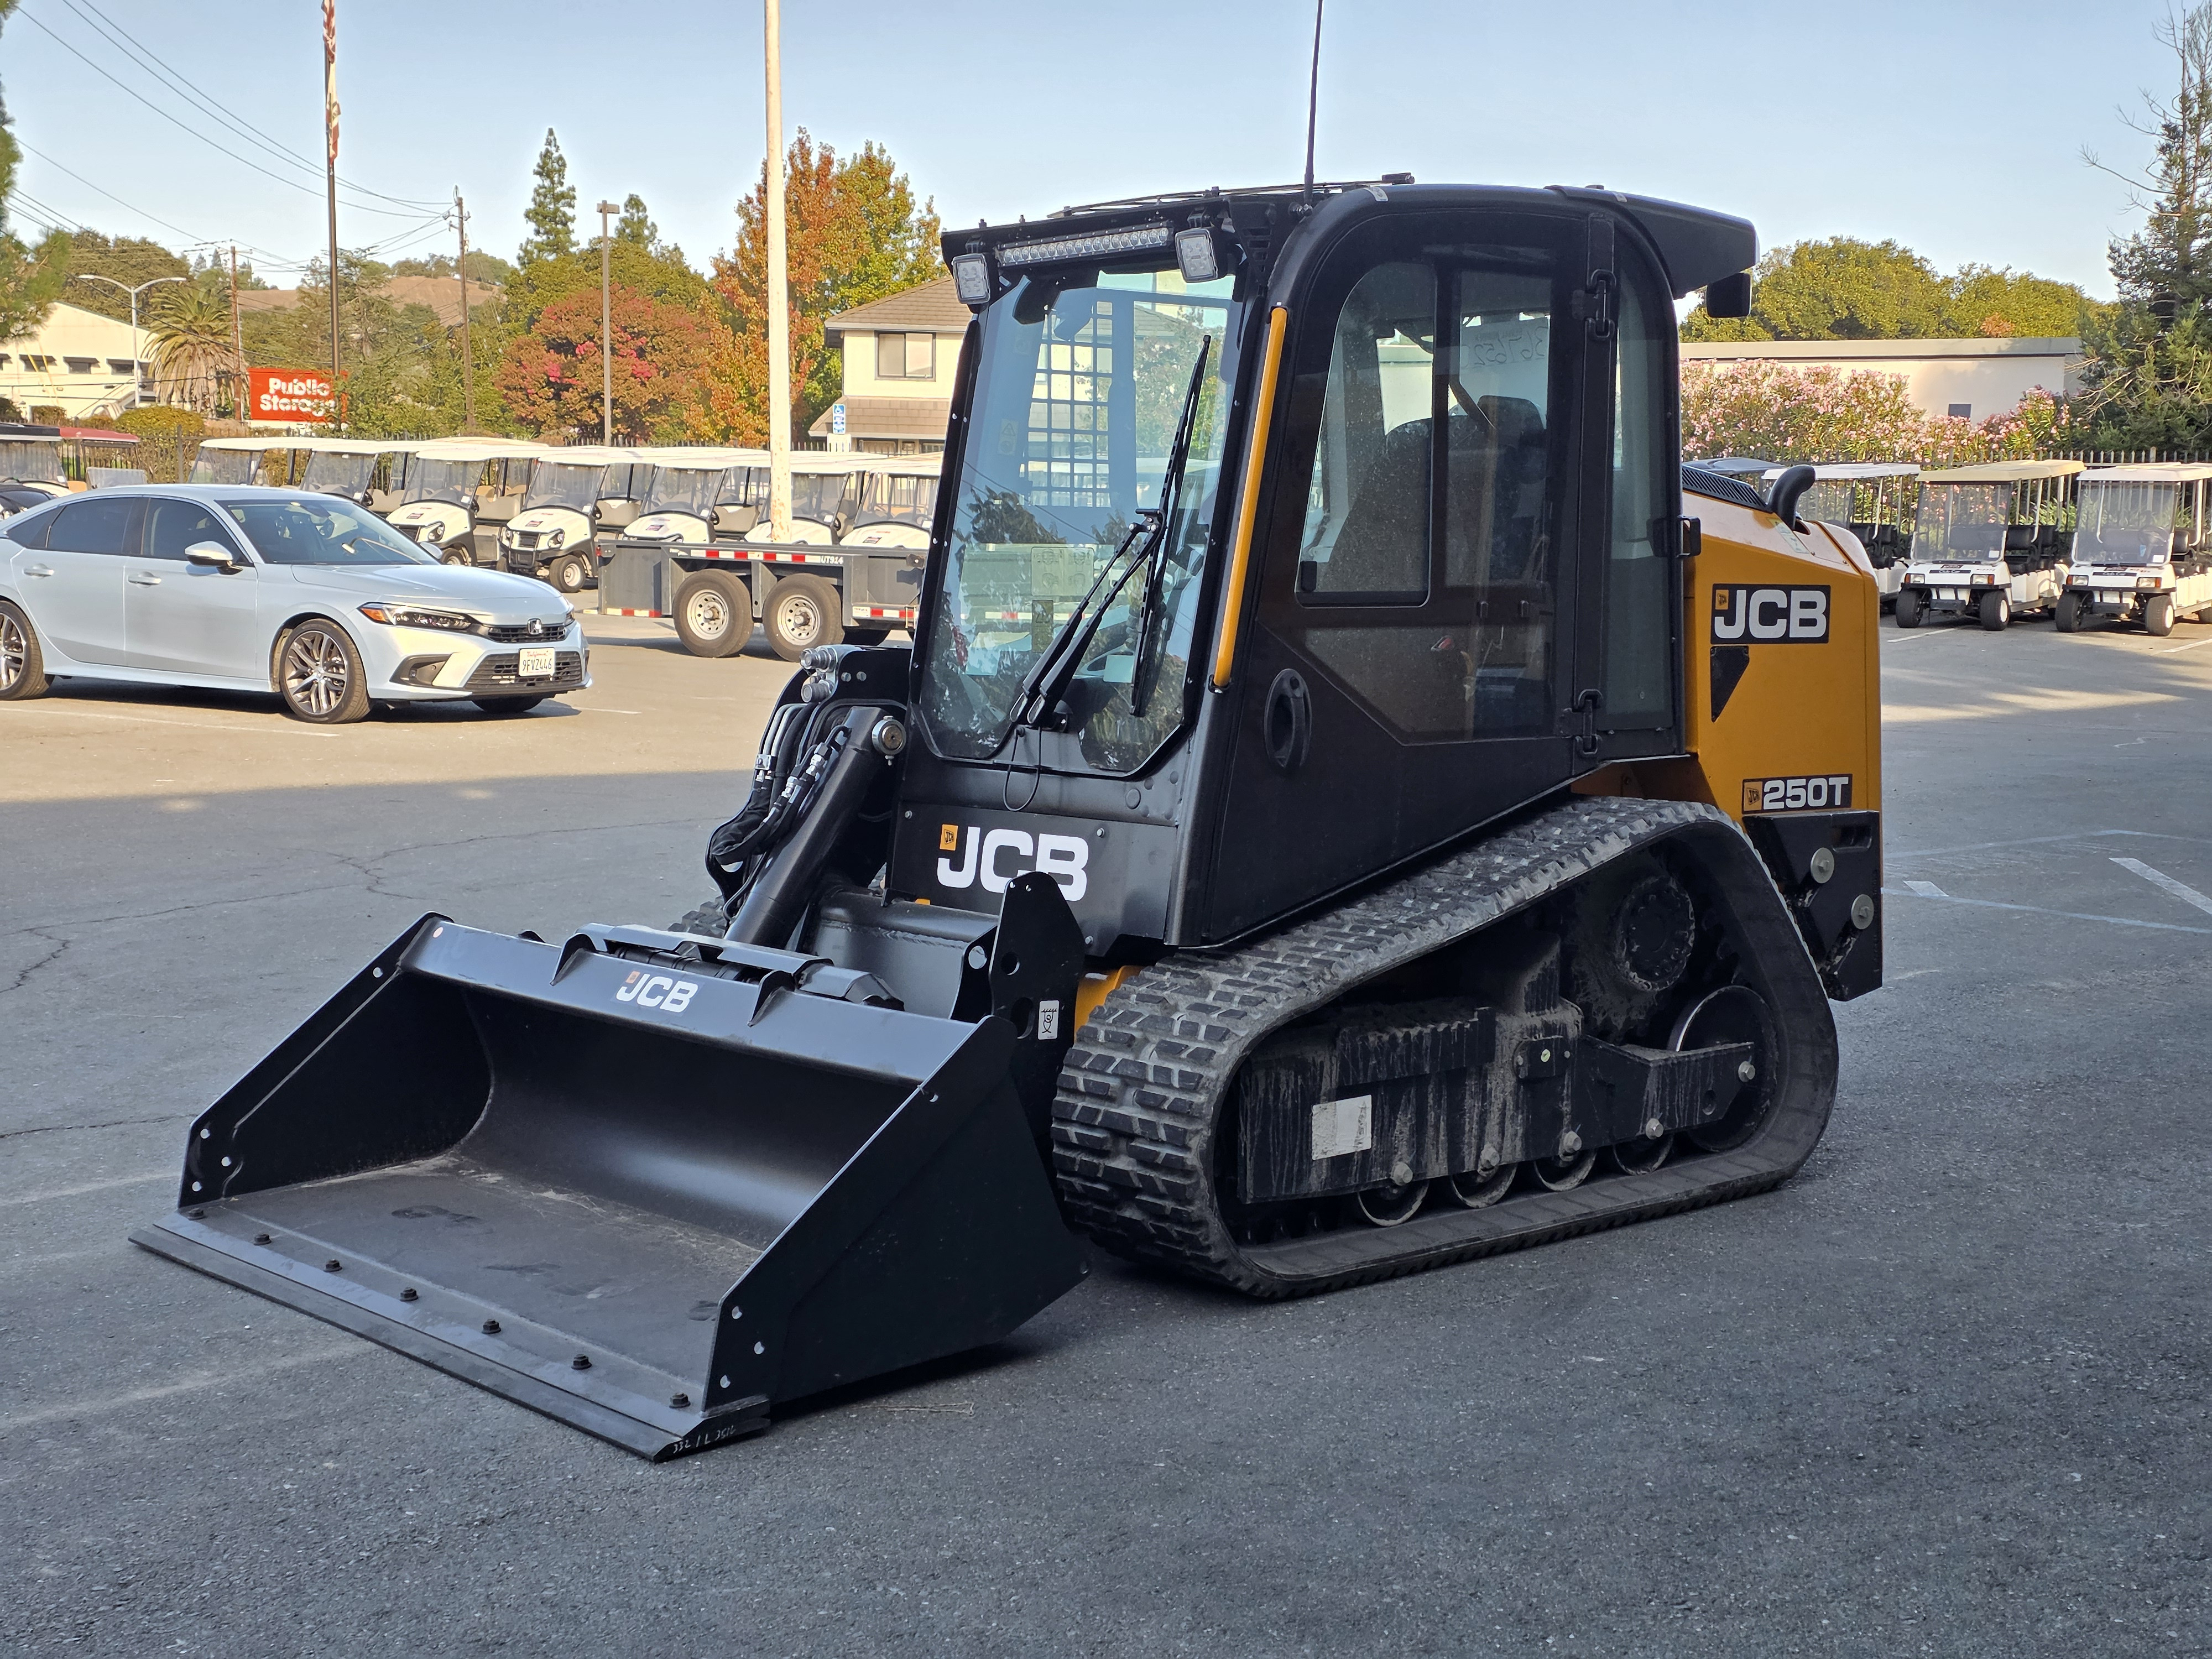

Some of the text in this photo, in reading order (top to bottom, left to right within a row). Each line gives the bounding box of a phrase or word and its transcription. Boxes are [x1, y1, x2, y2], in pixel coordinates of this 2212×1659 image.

[269, 378, 330, 397] Public
[821, 555, 844, 565] UT914
[1714, 589, 1827, 639] JCB
[1763, 776, 1849, 810] 250T
[937, 826, 1089, 901] JCB
[616, 973, 698, 1013] JCB
